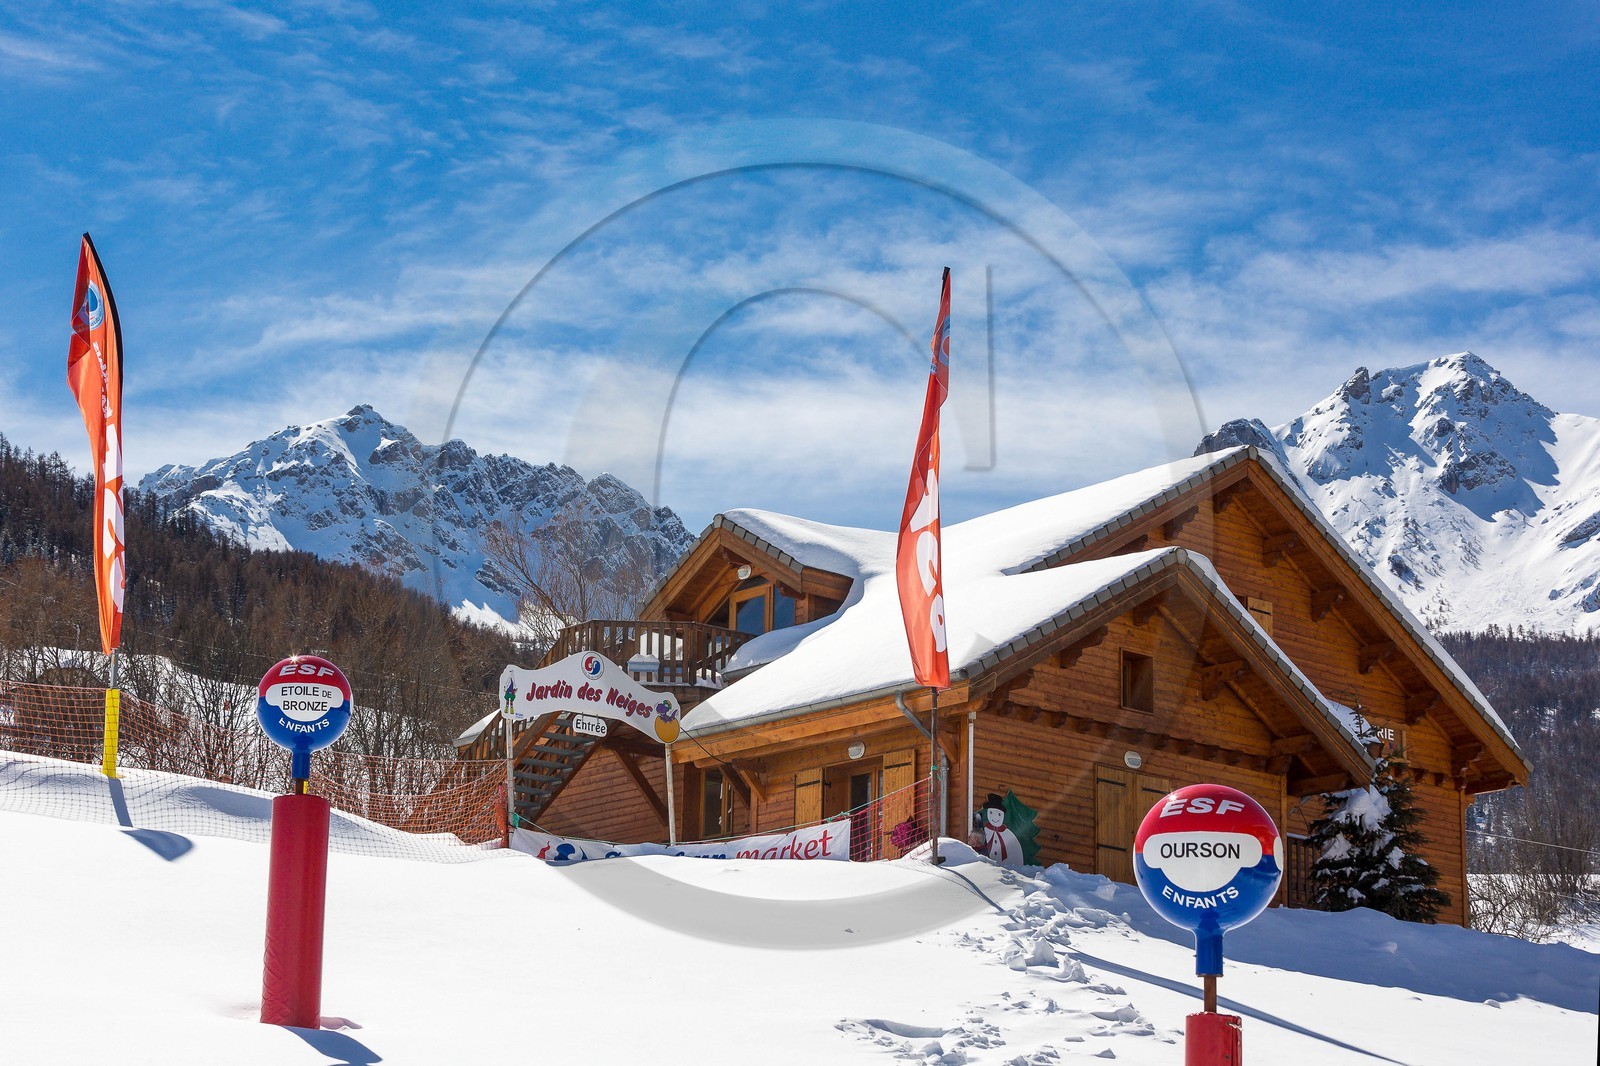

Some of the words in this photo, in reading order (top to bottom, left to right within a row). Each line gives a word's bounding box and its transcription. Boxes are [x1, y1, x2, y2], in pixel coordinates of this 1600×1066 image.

[279, 664, 335, 677] ESF
[281, 685, 319, 697] ETOILE
[322, 690, 332, 699] DE
[526, 679, 573, 702] Jardin
[577, 681, 603, 701] des
[606, 686, 653, 718] Neiges
[282, 700, 328, 712] BRONZE
[278, 717, 330, 733] ENFANTS
[575, 718, 606, 735] Entrée
[1376, 727, 1395, 741] RIE
[1160, 797, 1245, 818] ESF
[735, 829, 833, 860] market
[1160, 842, 1240, 859] OURSON
[1161, 885, 1239, 909] ENFANTS
